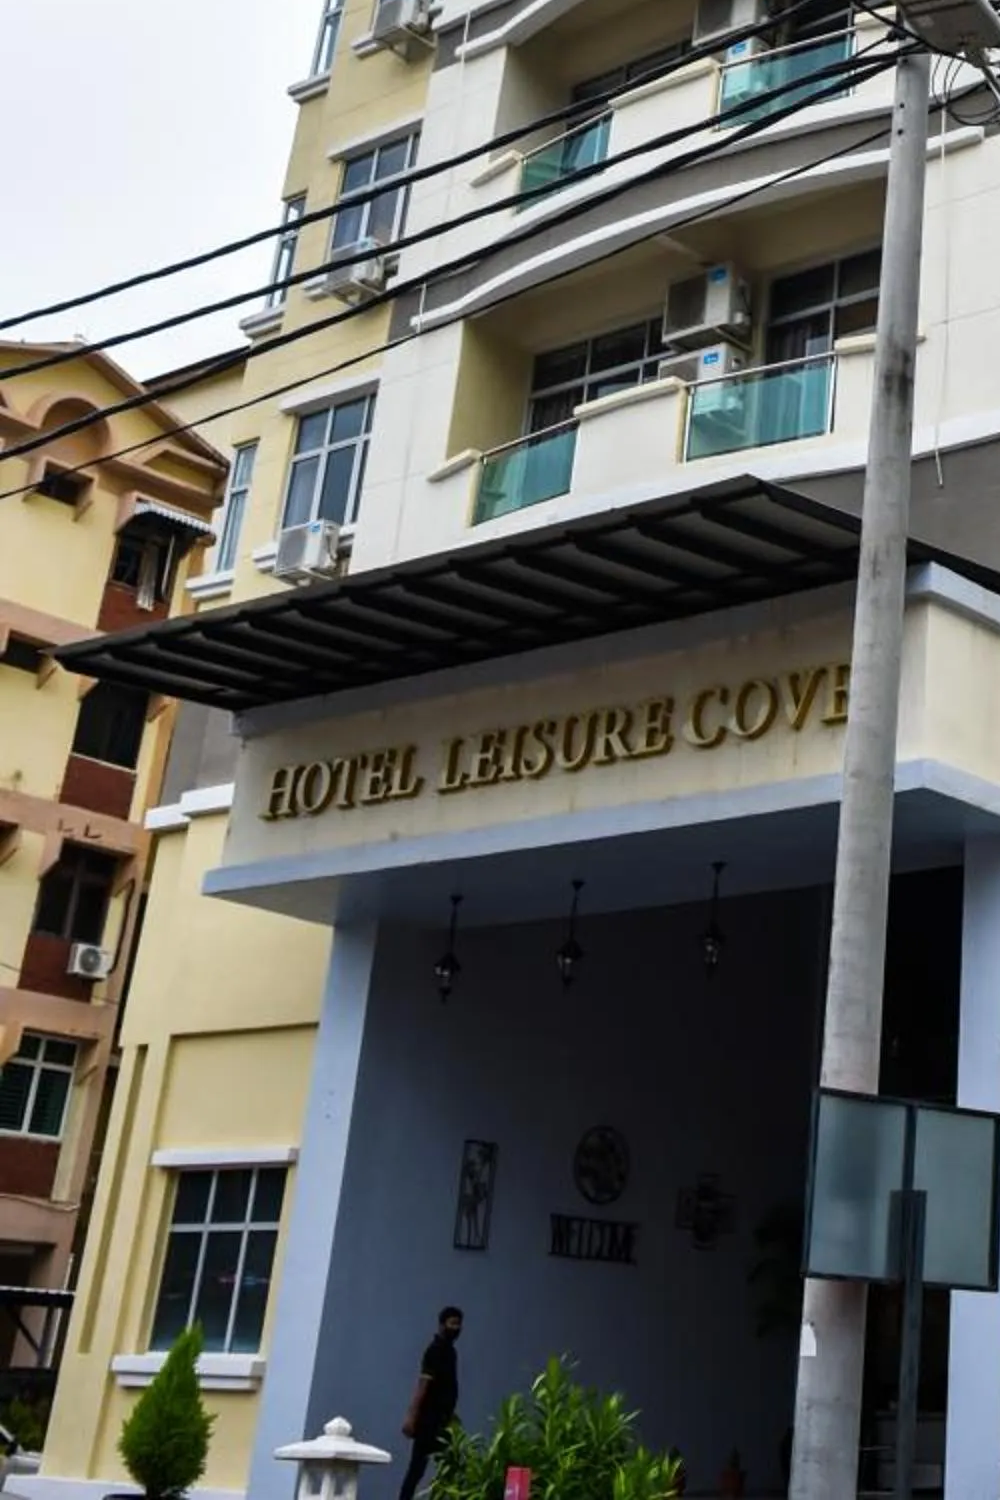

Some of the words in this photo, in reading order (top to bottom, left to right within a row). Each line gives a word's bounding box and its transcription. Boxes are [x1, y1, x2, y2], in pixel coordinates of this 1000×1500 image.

[259, 744, 425, 821] HOTEL
[437, 696, 675, 795] LEISURE
[683, 662, 851, 749] COVE
